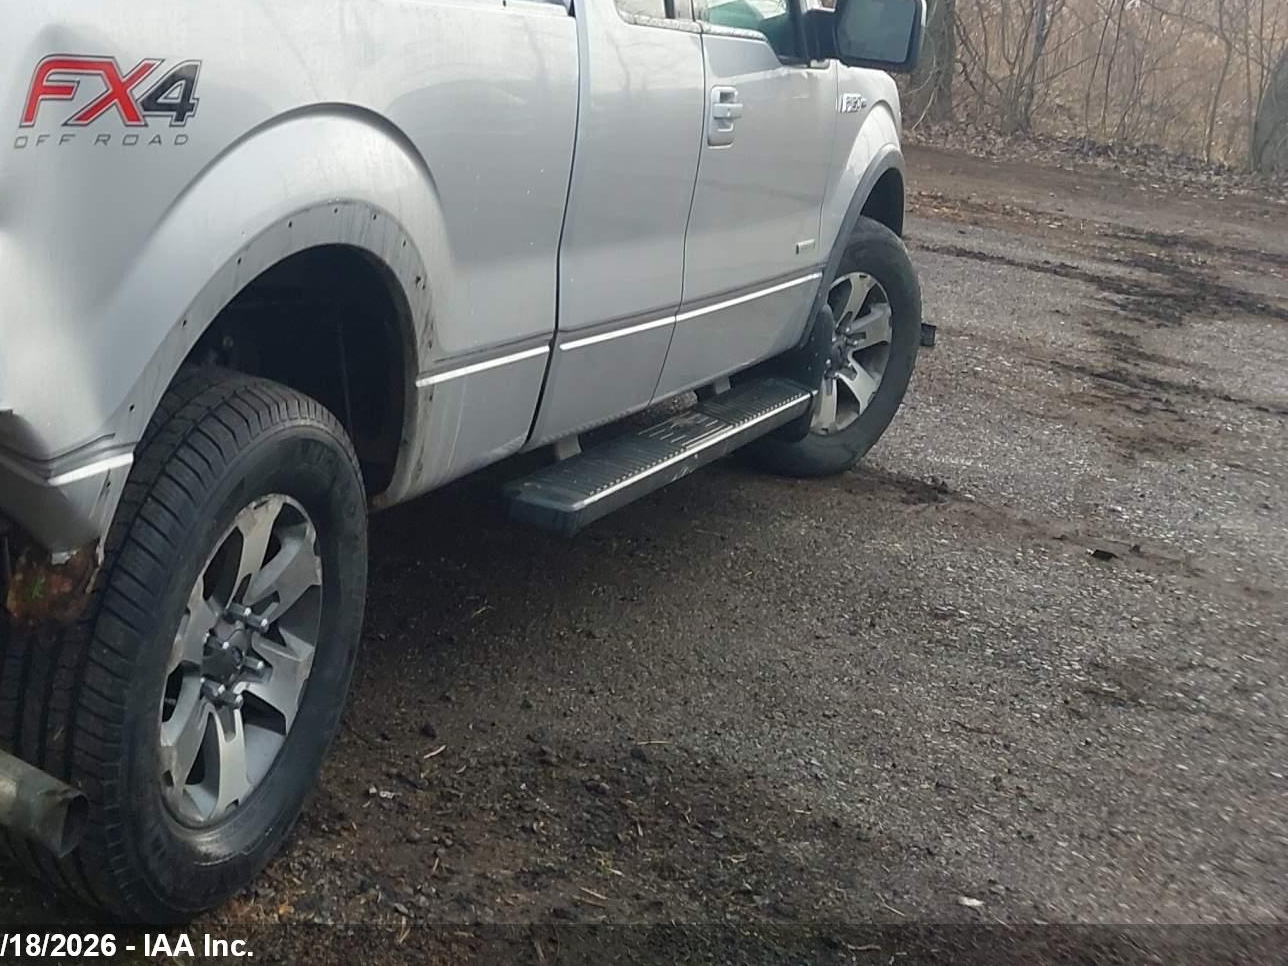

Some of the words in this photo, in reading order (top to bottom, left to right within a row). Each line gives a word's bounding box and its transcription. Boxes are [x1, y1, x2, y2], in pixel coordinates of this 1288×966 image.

[19, 53, 202, 128] FX4
[13, 134, 76, 149] OFF
[93, 133, 189, 147] ROAD
